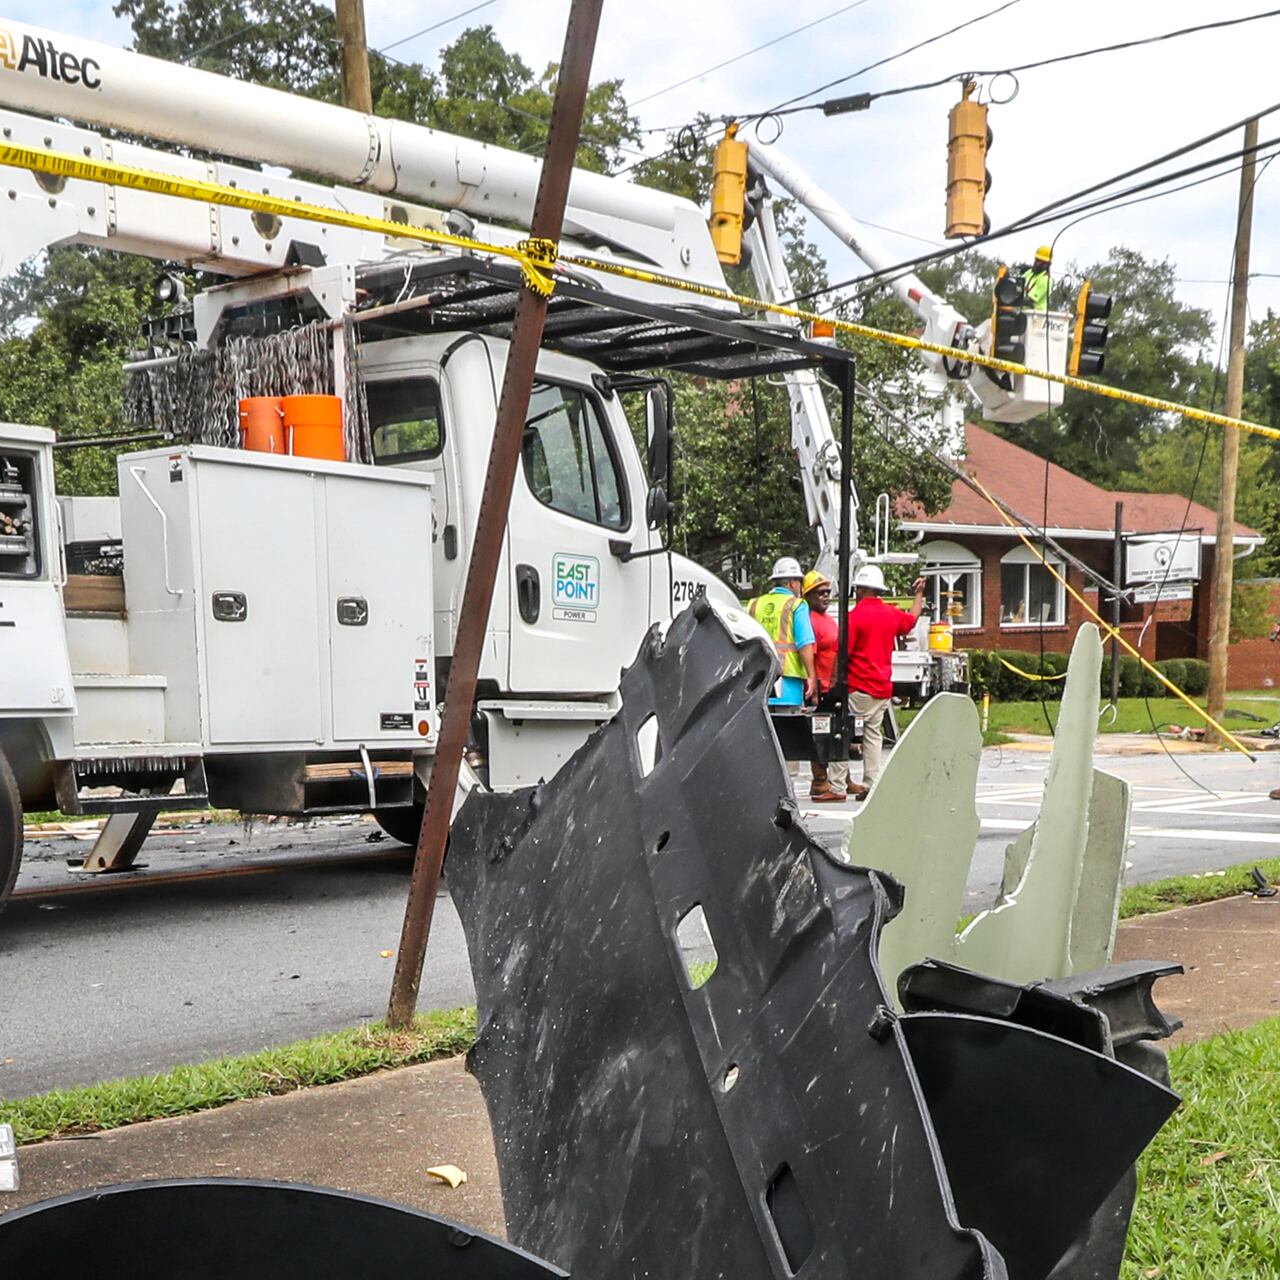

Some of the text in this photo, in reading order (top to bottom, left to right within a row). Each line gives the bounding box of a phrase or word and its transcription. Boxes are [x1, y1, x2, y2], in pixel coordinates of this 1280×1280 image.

[17, 34, 102, 90] Altec
[556, 561, 591, 581] EAST
[556, 580, 595, 600] POINT
[563, 611, 586, 619] POWER
